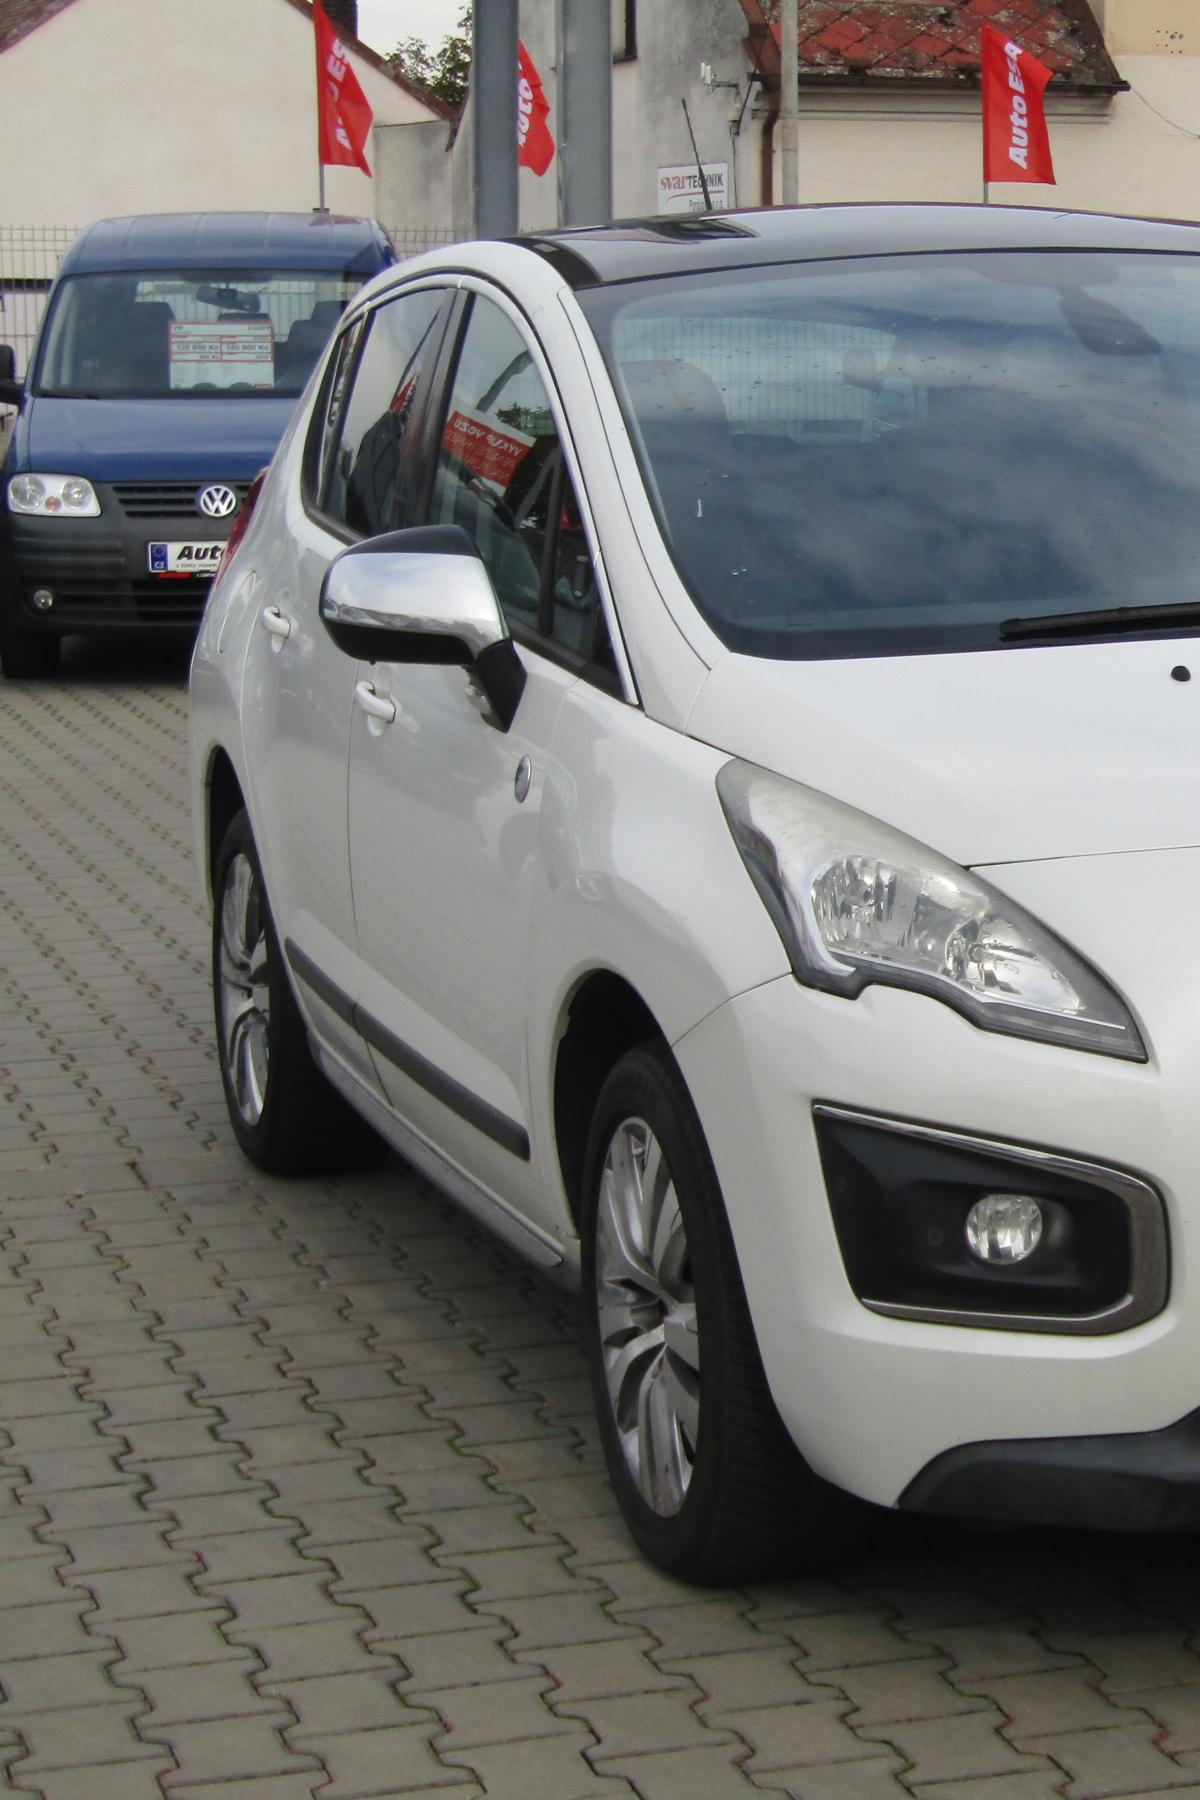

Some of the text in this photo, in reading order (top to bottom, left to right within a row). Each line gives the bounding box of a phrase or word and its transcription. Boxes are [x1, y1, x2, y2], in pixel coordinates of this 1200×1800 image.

[1009, 95, 1028, 170] Auto
[154, 545, 224, 569] CZ Aut
